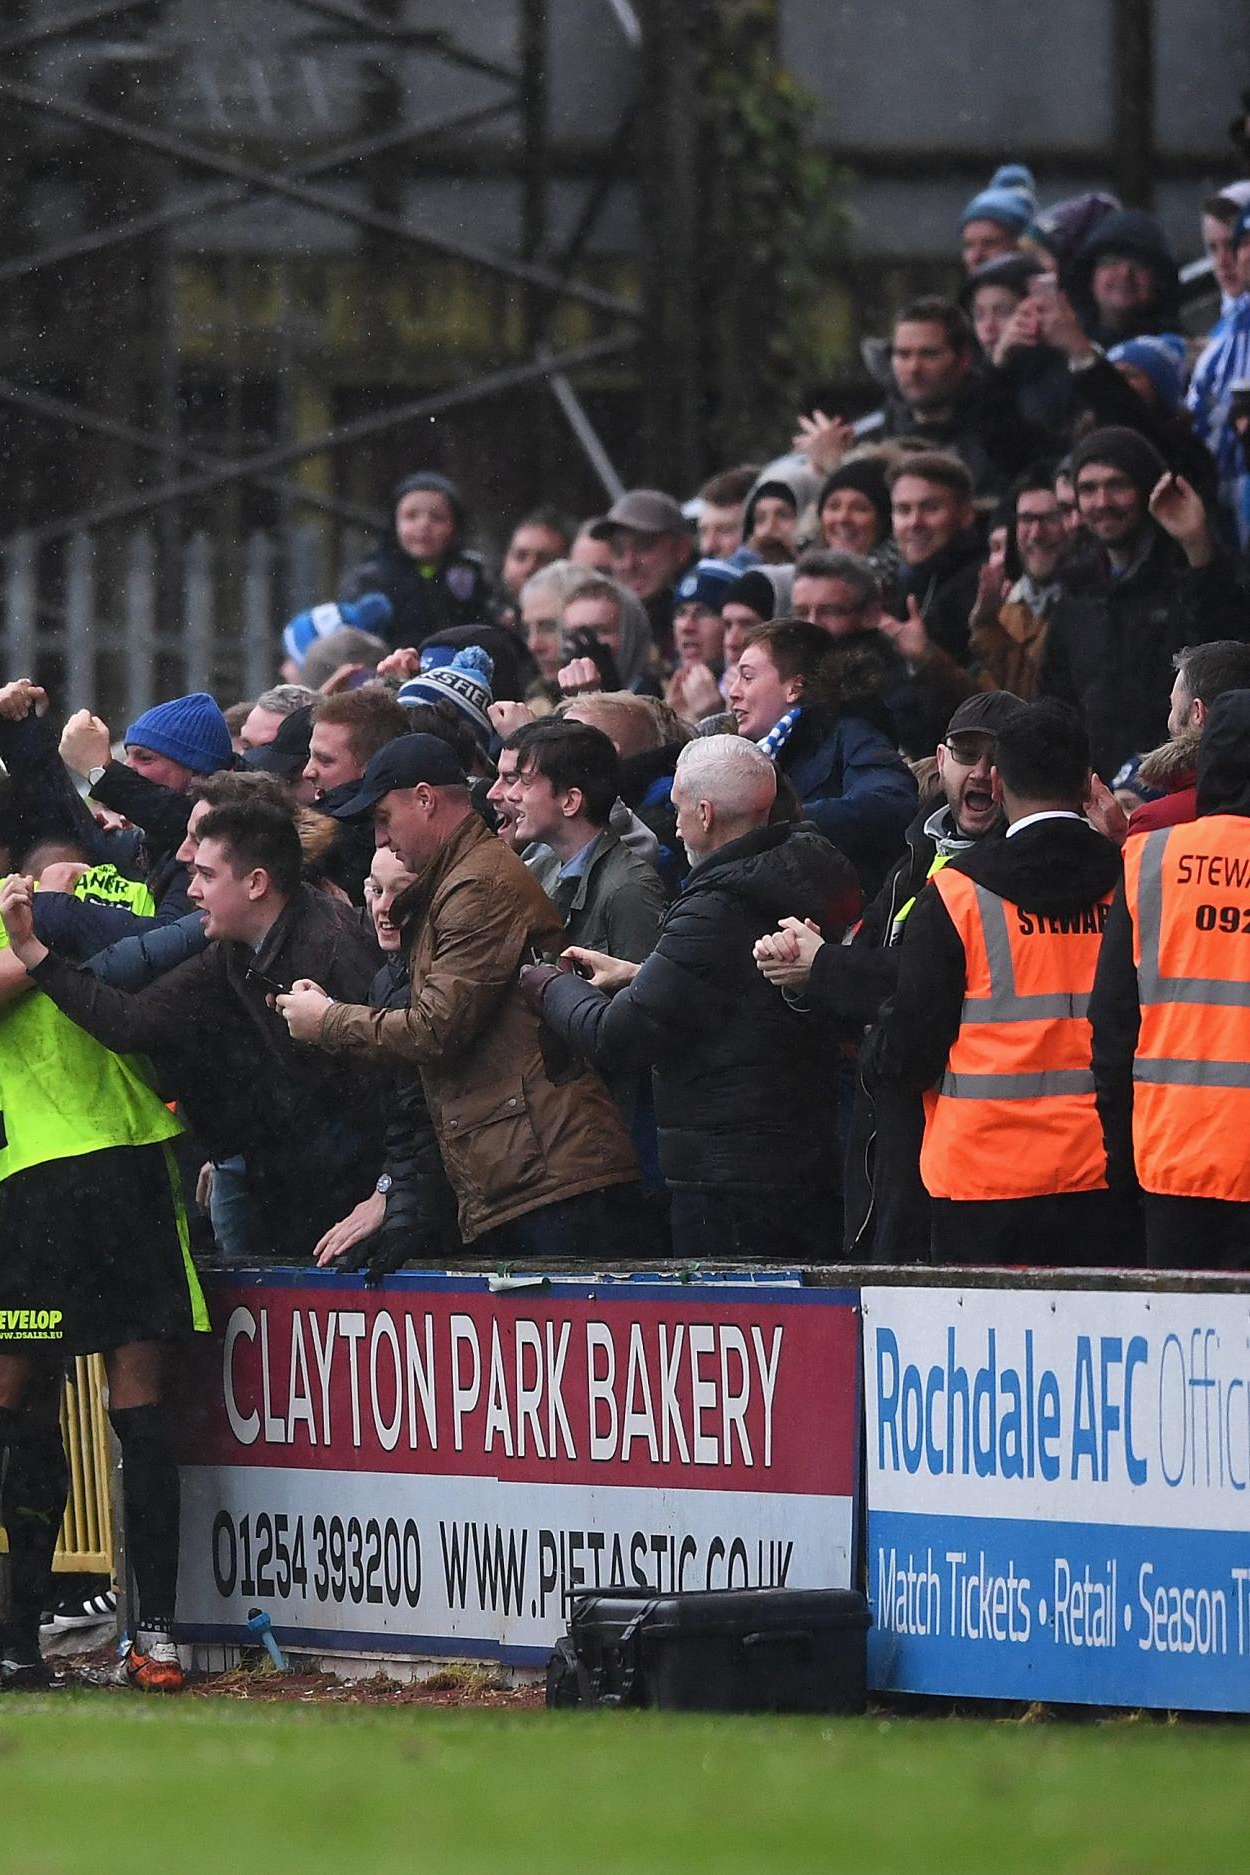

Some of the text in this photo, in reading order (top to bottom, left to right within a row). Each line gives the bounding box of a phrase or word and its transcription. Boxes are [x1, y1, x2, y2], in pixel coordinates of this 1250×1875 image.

[74, 871, 129, 894] ANER
[223, 1306, 784, 1468] CLAYTON PARK BAKERY
[875, 1326, 1061, 1482] Rochdale
[1070, 1335, 1148, 1486] AFC
[212, 1510, 308, 1600] 01254
[312, 1514, 422, 1608] 393200
[877, 1547, 942, 1636] Match
[945, 1550, 1031, 1643] Tickets
[1053, 1558, 1117, 1647] Retail
[1138, 1562, 1227, 1655] Season
